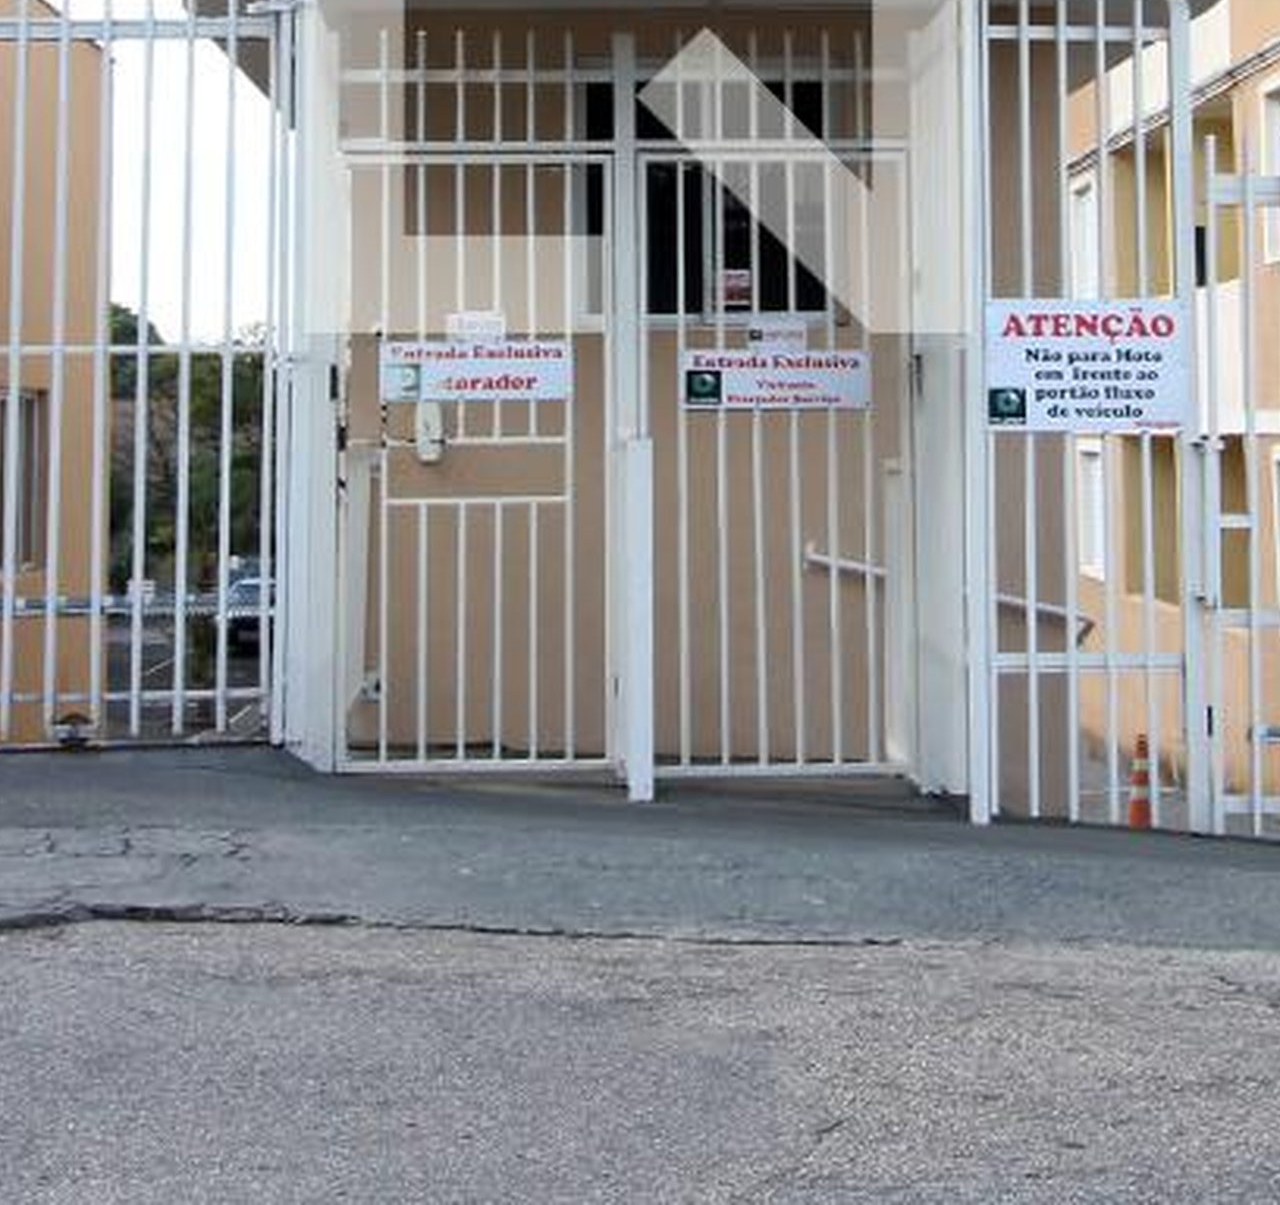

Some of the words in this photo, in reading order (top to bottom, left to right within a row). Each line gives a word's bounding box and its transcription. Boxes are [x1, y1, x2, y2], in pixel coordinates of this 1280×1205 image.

[1001, 307, 1174, 345] ATENÇÃO
[693, 354, 768, 369] Entrada
[773, 354, 860, 370] Exclusiva
[1024, 348, 1063, 363] Não
[1067, 351, 1111, 365] para
[1115, 348, 1163, 363] Moto
[1034, 370, 1064, 381] em
[1072, 367, 1132, 381] frente
[1136, 370, 1159, 381] ao
[1034, 385, 1099, 402] portão
[1047, 405, 1069, 418] de
